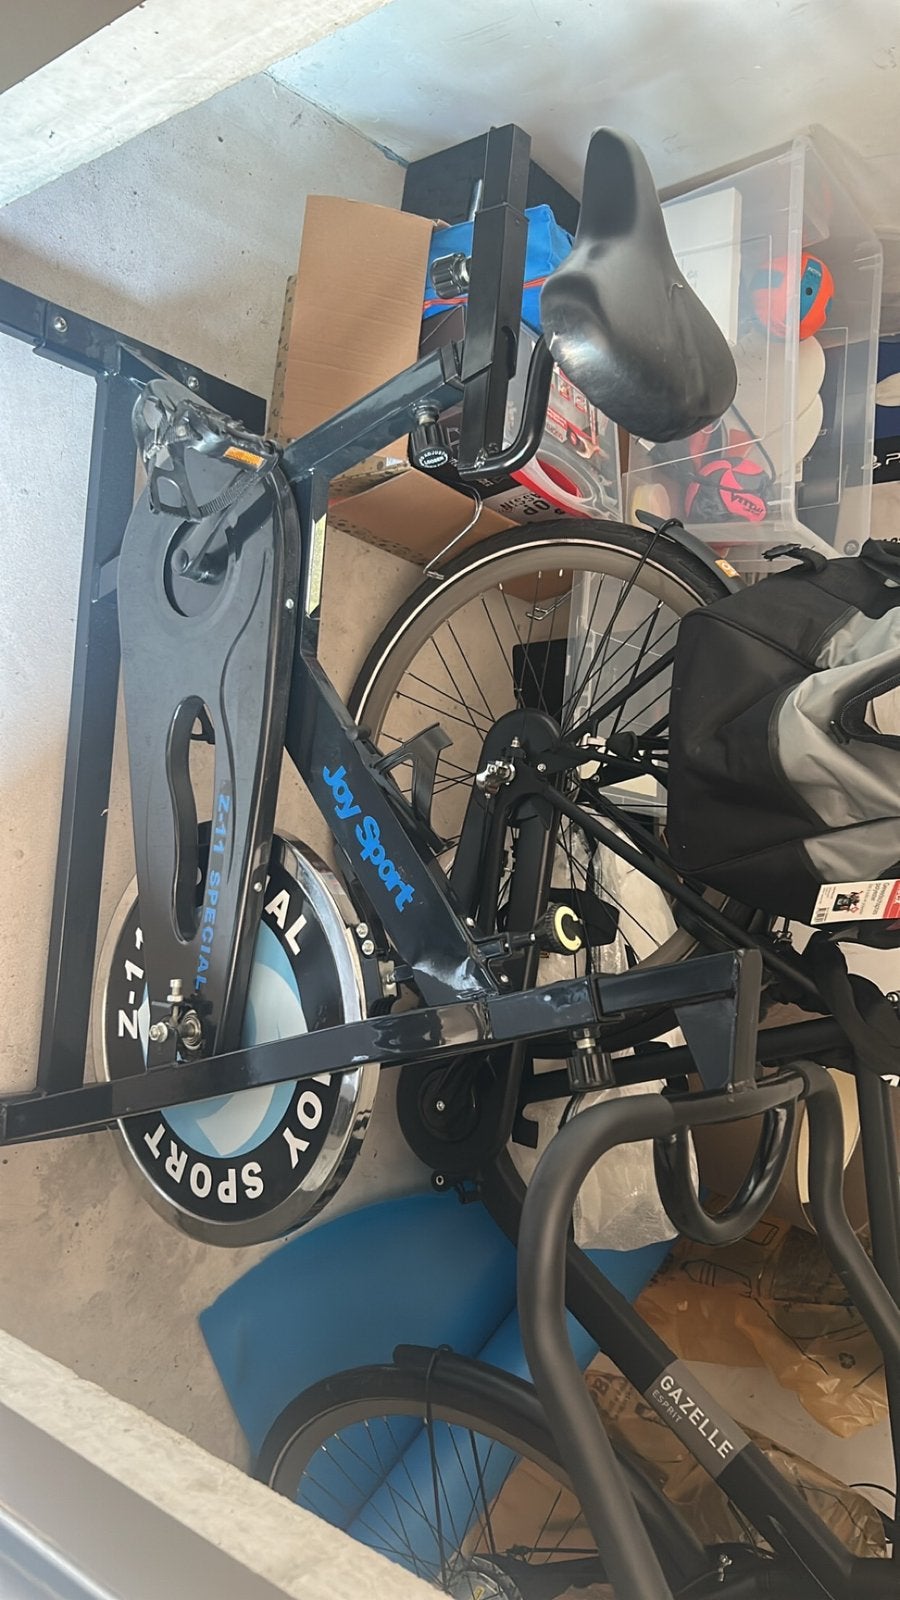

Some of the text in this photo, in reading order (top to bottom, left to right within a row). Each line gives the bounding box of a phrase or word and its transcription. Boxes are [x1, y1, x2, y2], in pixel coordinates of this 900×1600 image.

[323, 765, 416, 913] Joy Sport
[195, 794, 231, 990] Z-11 SPECIAL
[143, 1123, 264, 1204] SPORT
[652, 1389, 683, 1423] ESPRIT
[660, 1375, 734, 1459] GAZELLE
